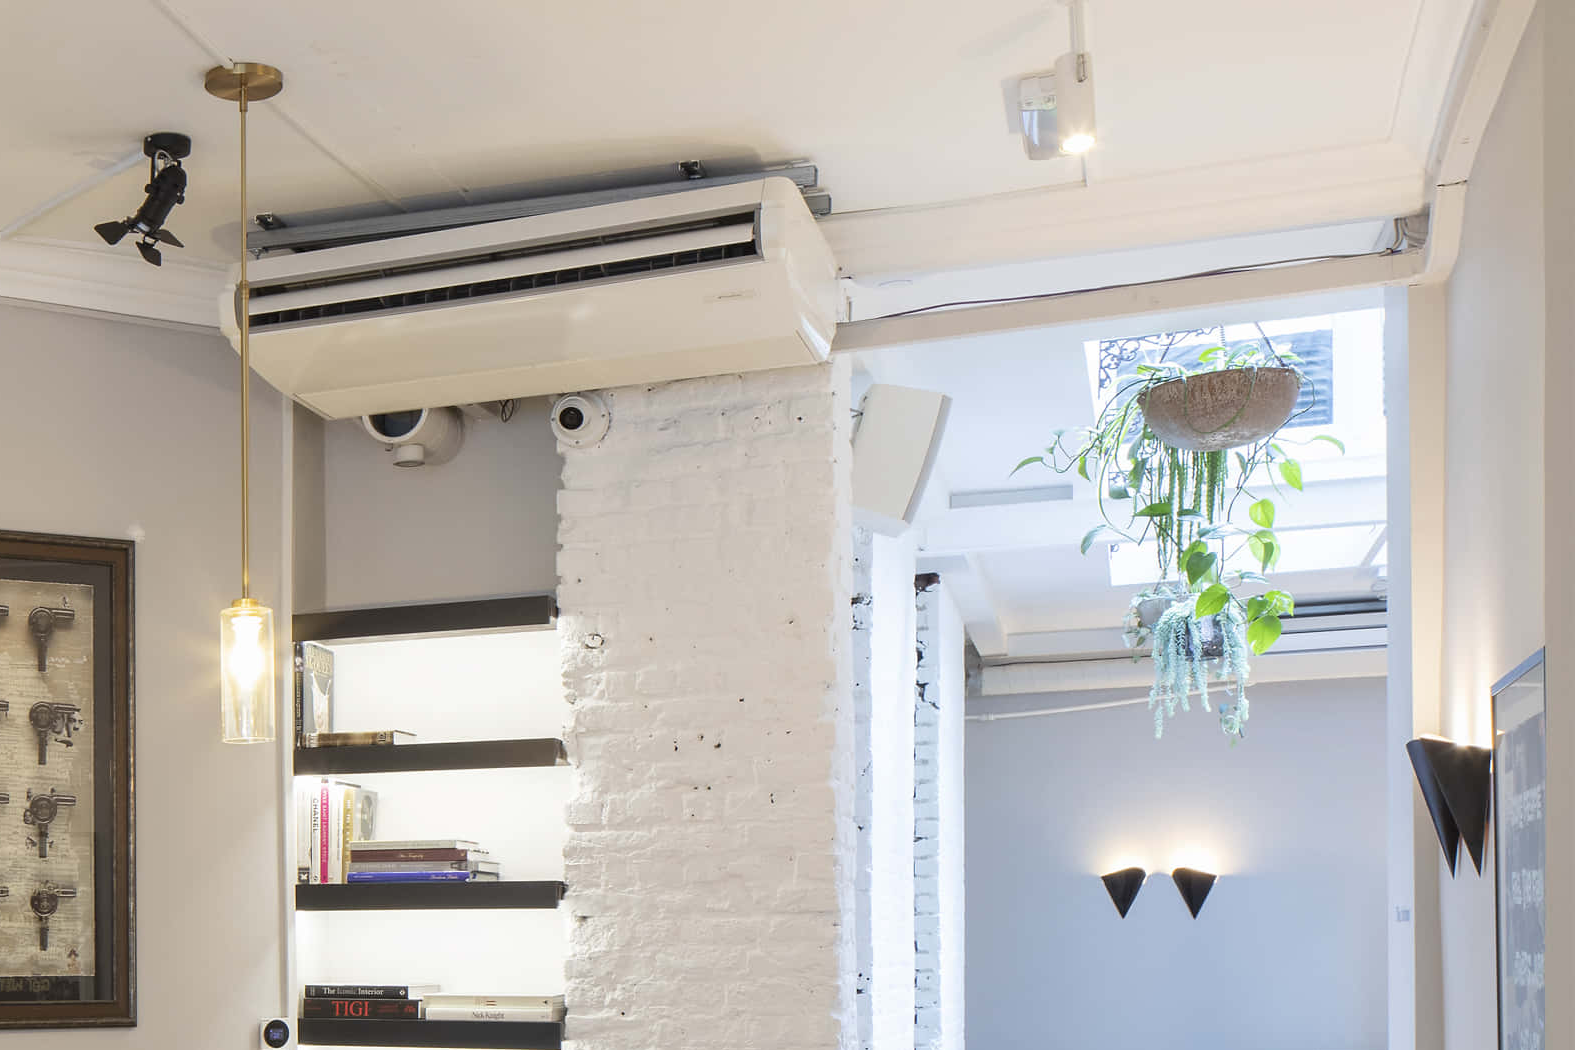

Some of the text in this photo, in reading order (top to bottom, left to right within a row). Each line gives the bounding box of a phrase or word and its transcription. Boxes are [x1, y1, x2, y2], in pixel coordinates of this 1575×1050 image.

[321, 986, 336, 995] The
[357, 987, 385, 995] Interior
[331, 1001, 370, 1017] TIGI
